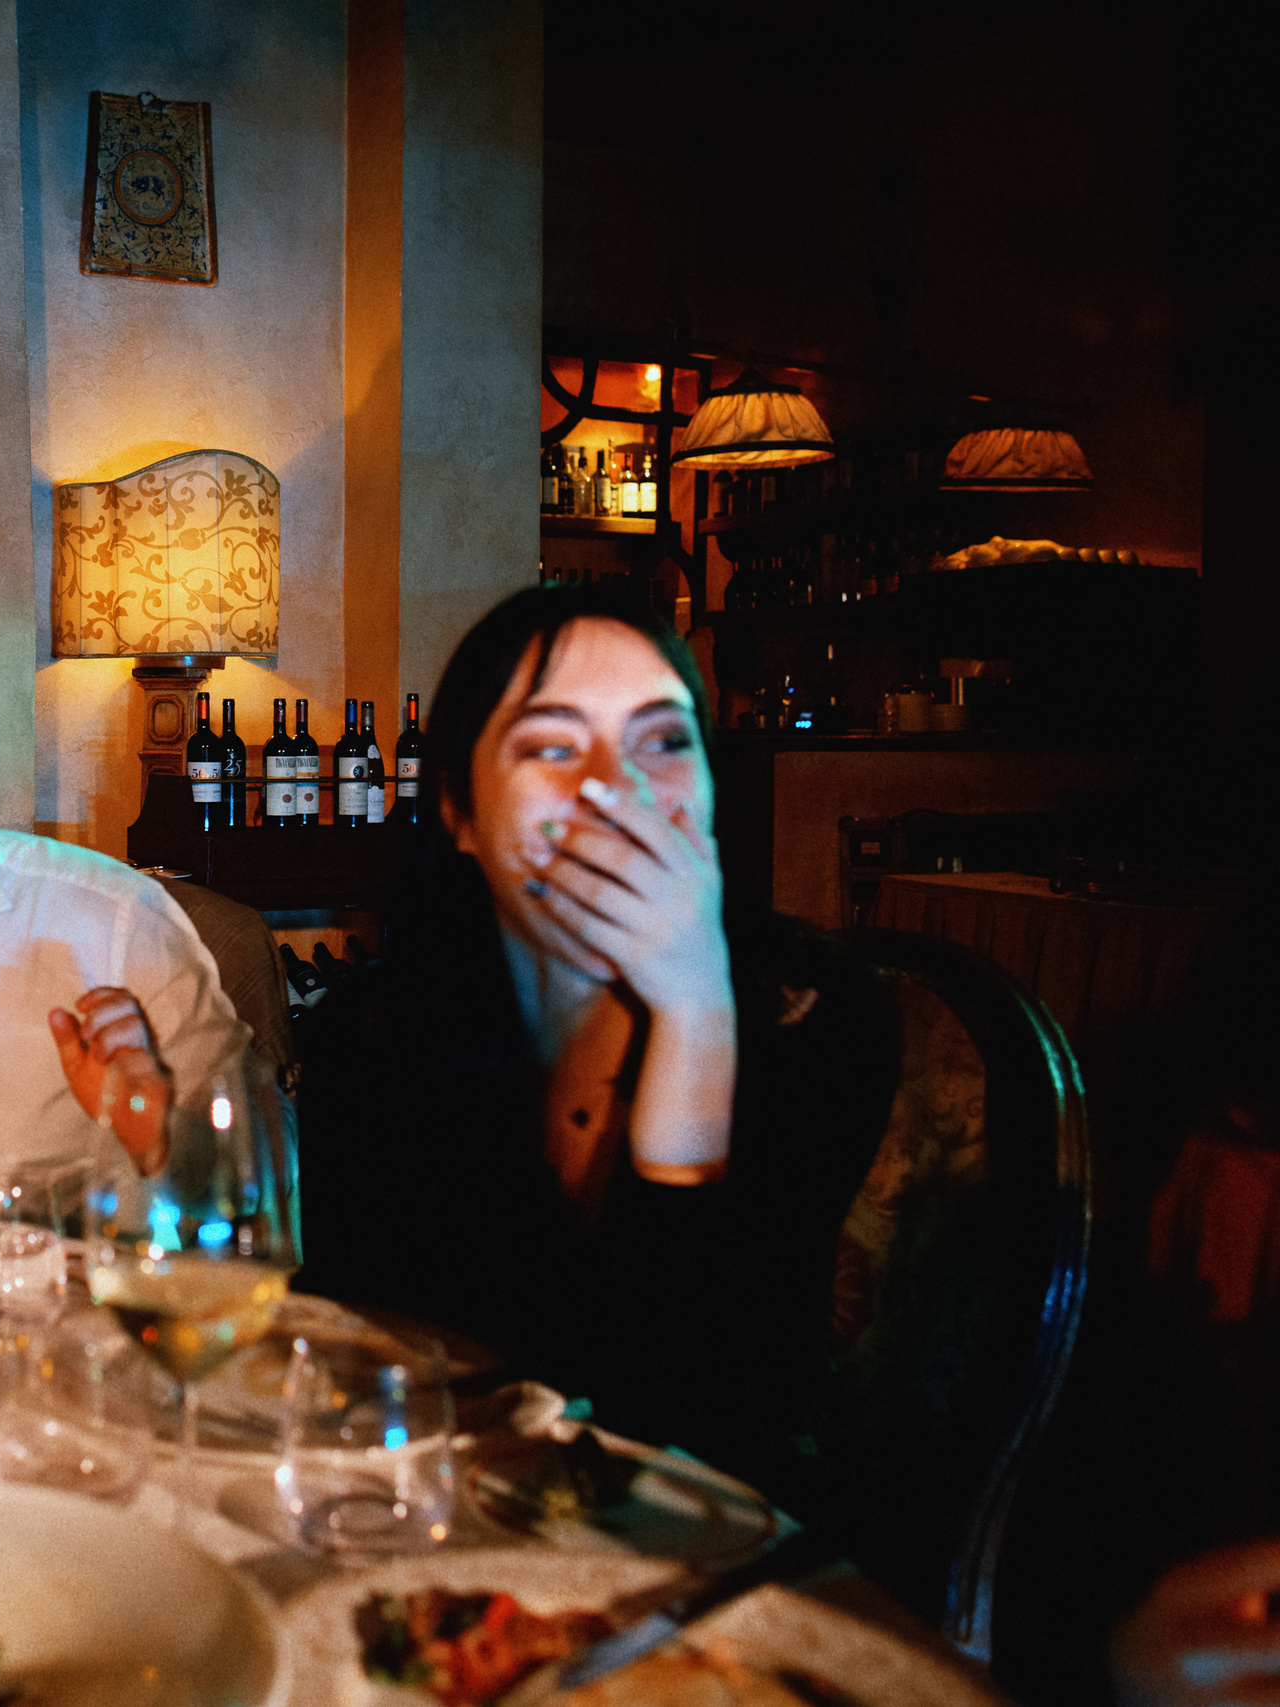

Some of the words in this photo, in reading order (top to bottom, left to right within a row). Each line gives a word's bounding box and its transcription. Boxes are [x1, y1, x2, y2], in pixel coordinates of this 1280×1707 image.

[191, 768, 207, 779] 50
[223, 759, 242, 777] 25
[403, 763, 417, 774] 50
